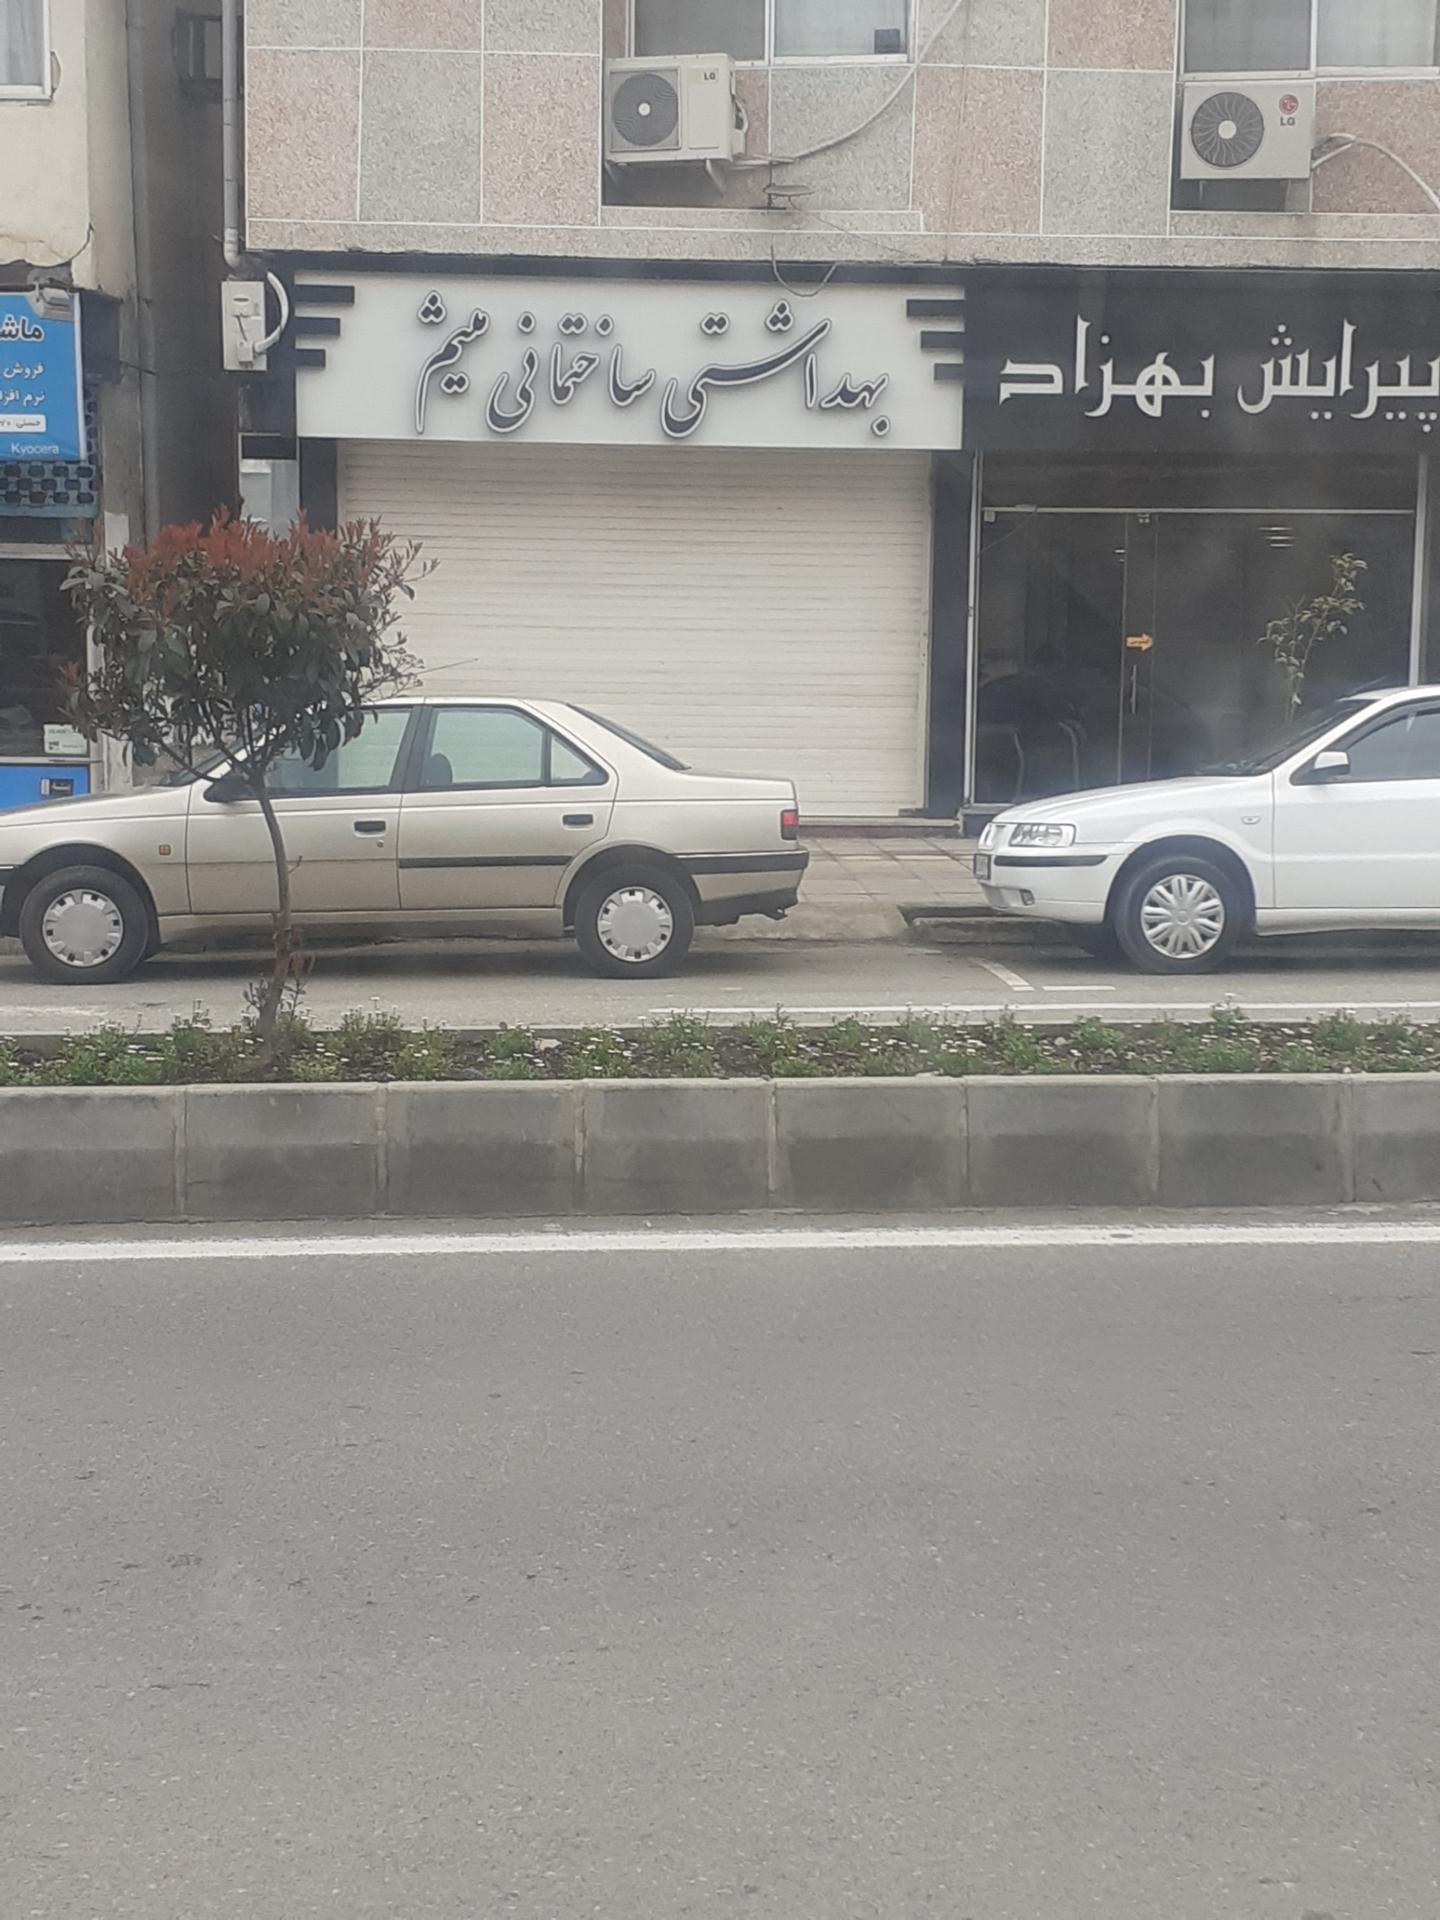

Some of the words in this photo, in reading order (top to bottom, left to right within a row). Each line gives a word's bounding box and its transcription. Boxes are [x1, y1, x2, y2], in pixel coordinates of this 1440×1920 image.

[703, 72, 717, 81] LG
[1279, 116, 1296, 126] LG
[3, 361, 44, 379] فروش
[416, 290, 490, 434] میثم
[486, 311, 654, 434] ساختمانی
[661, 299, 894, 437] بهداشتی
[999, 313, 1215, 419] بهزاد
[1237, 318, 1440, 433] پیرایش
[23, 391, 45, 407] نرم
[10, 442, 60, 456] Kyocera
